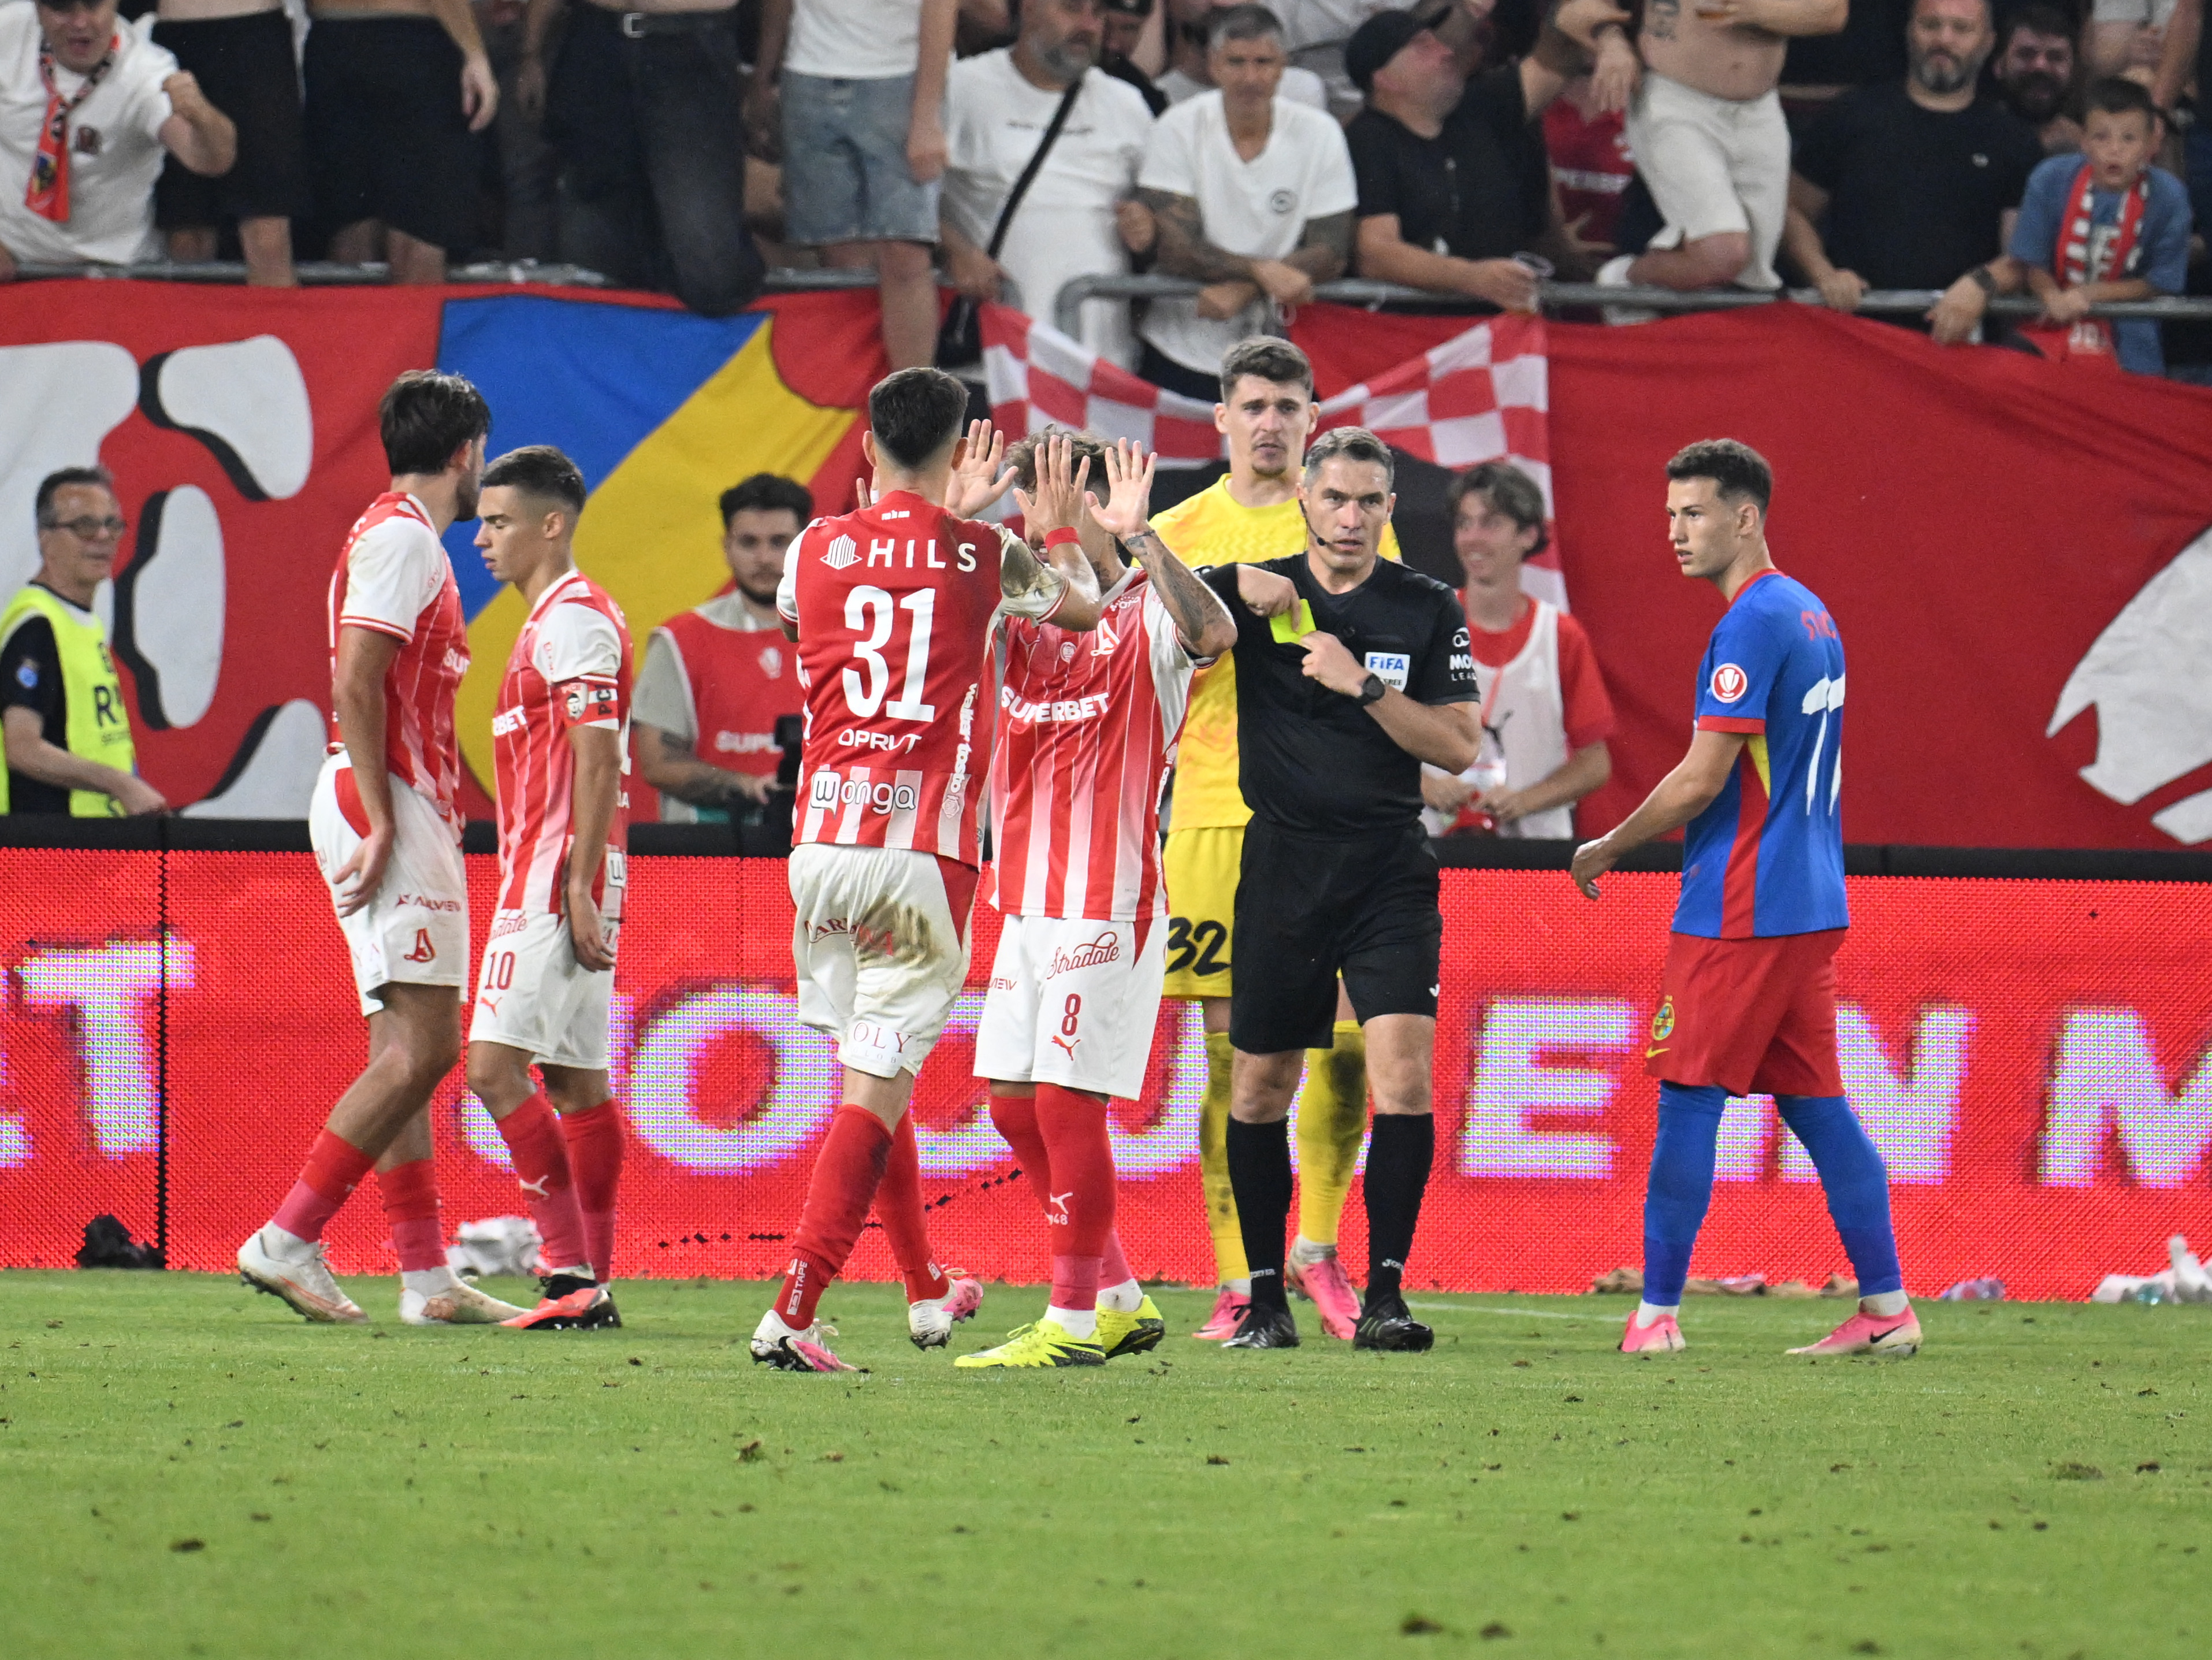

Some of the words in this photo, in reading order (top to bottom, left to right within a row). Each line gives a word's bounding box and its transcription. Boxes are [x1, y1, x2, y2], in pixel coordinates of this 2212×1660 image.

[867, 539, 977, 573] HILS
[842, 585, 936, 722] 31
[1370, 656, 1404, 670] FIFA
[1449, 653, 1474, 670] MO
[1047, 931, 1120, 980] Stradale
[1165, 916, 1232, 977] 32
[485, 951, 516, 990] 10
[1061, 993, 1081, 1037] 8
[1456, 994, 1638, 1180] E
[794, 1260, 808, 1289] TAPE
